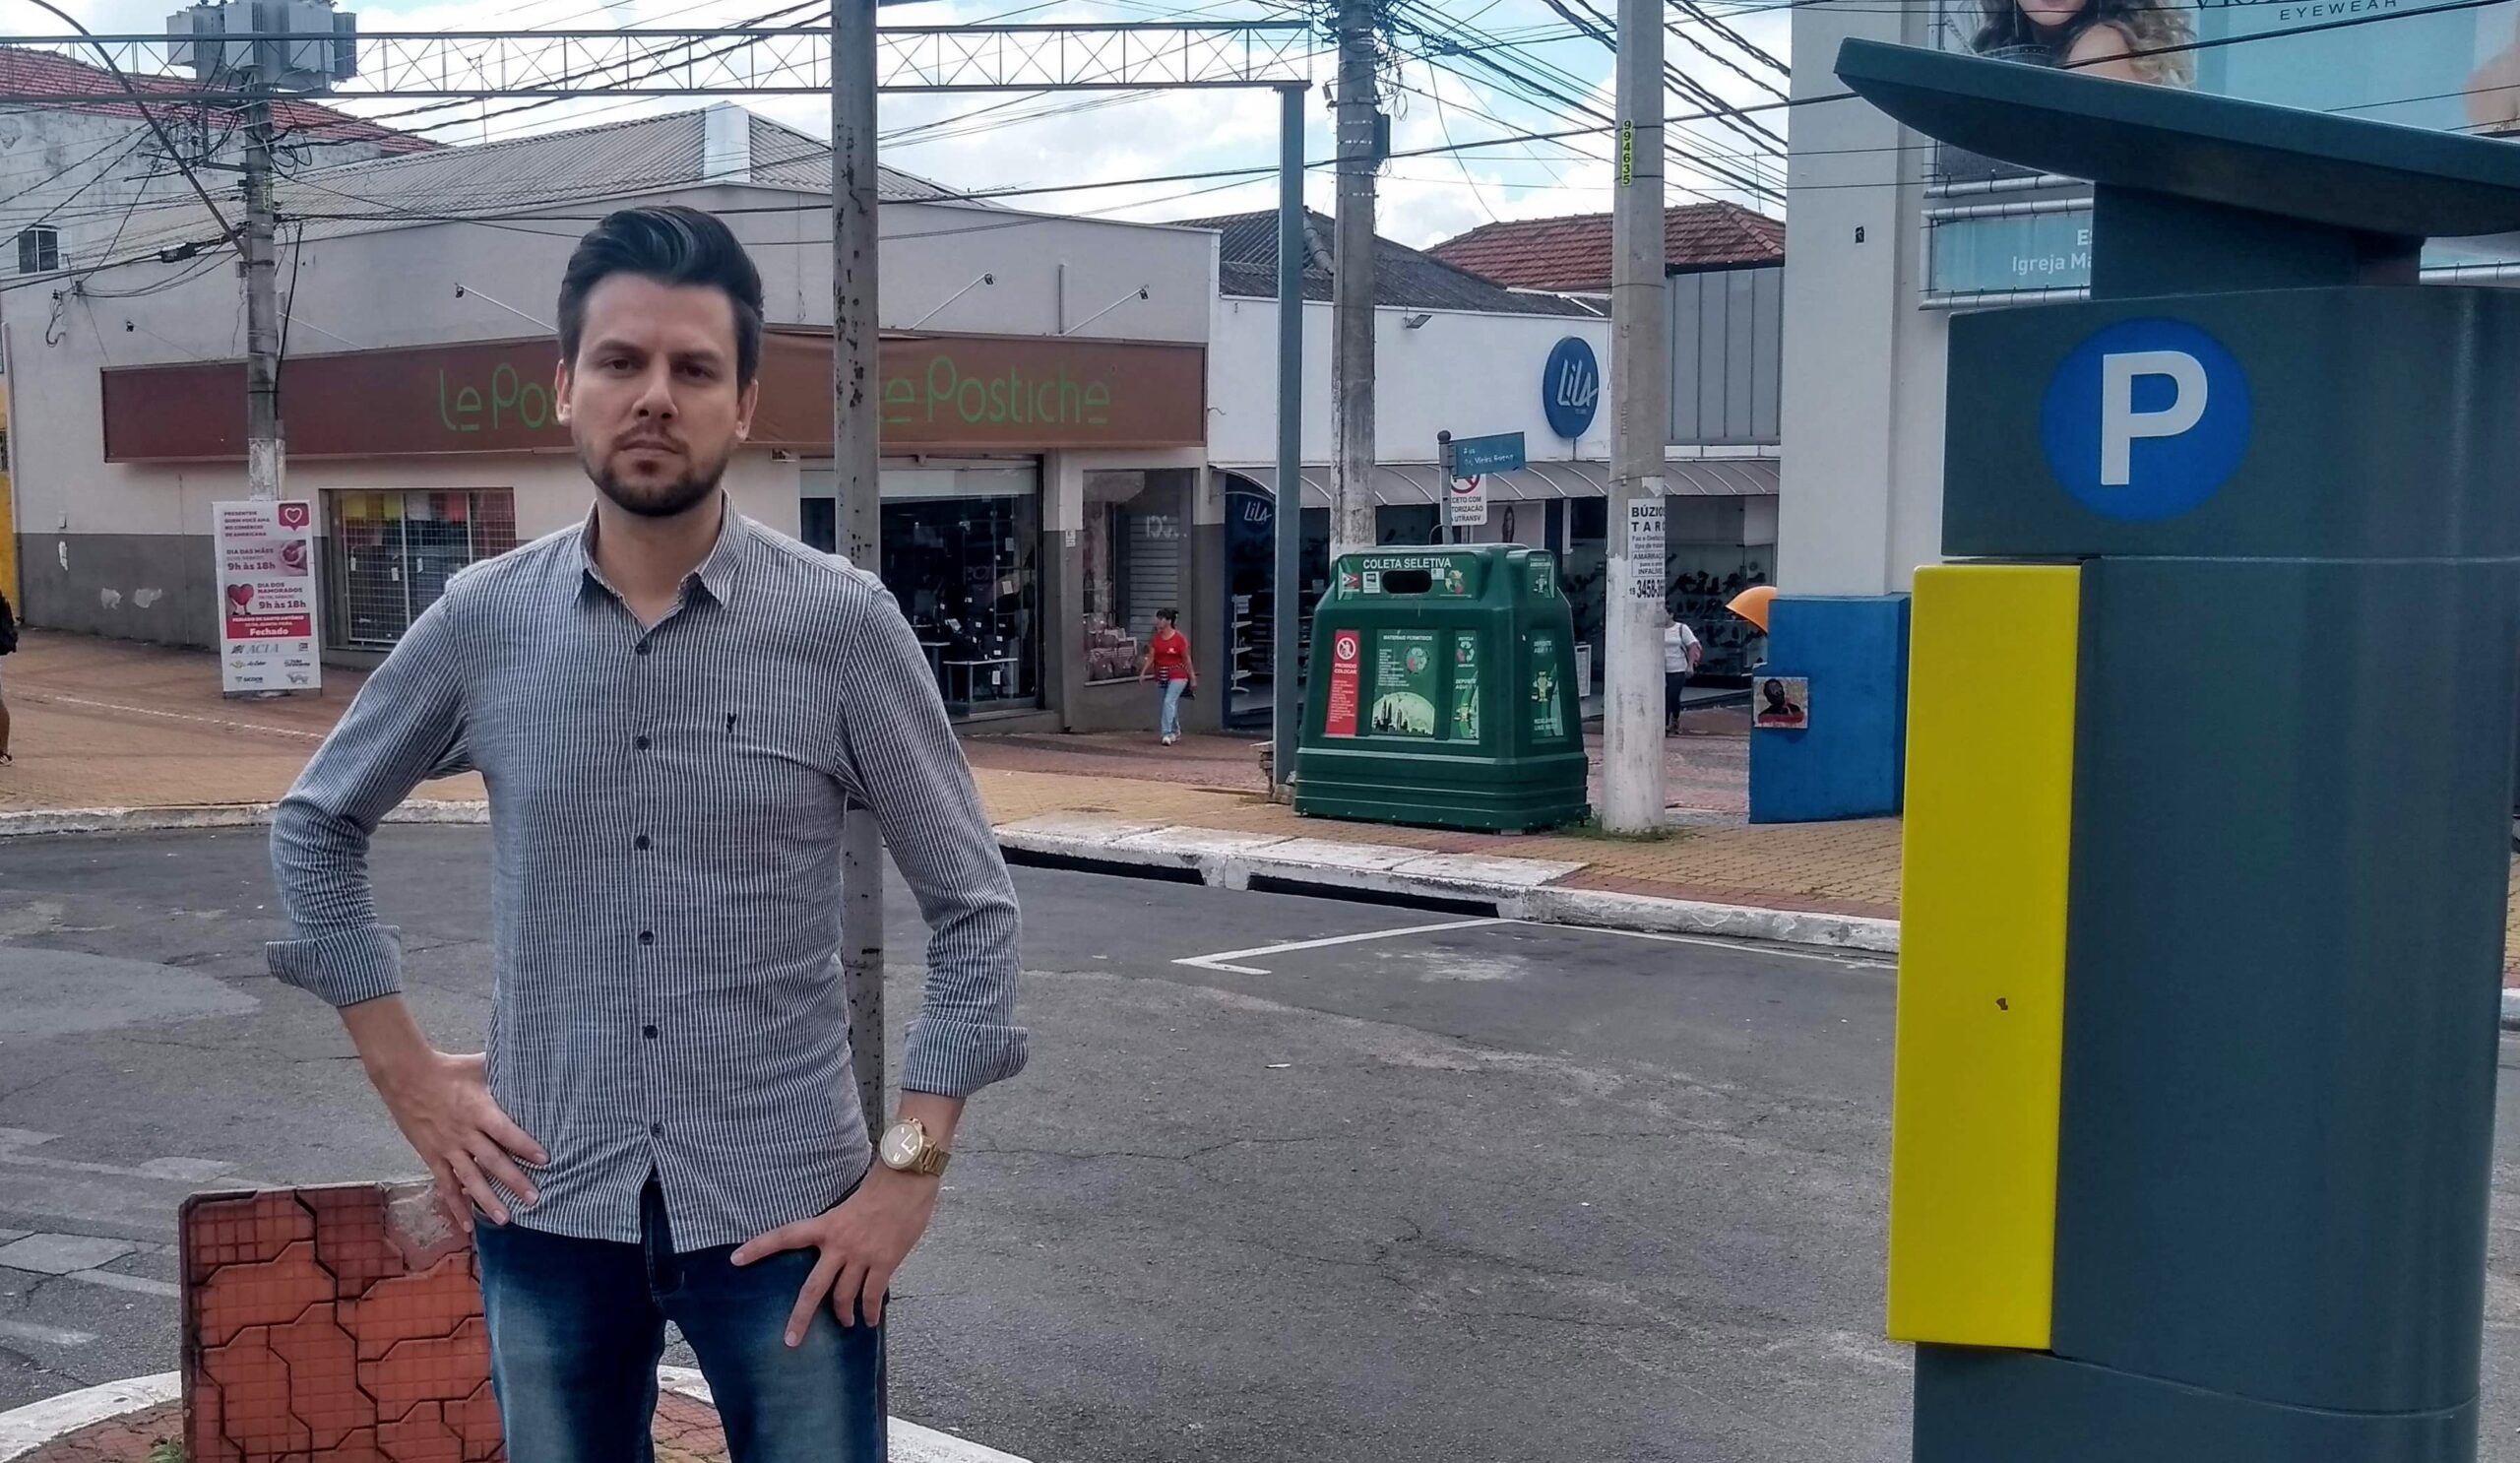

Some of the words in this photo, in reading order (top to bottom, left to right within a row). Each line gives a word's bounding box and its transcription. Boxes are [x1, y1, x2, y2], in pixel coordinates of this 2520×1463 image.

[2280, 0, 2397, 21] EYEWEAR
[1622, 120, 1632, 185] 994635
[2077, 228, 2093, 246] E
[2012, 254, 2065, 276] Igreja
[879, 377, 915, 423] e
[926, 354, 1111, 424] Postiche
[439, 369, 482, 431] Le
[2101, 350, 2209, 486] P
[243, 561, 255, 570] às
[257, 561, 276, 570] 18h
[1362, 558, 1402, 569] COLETA
[1404, 557, 1452, 569] SELETIVA
[259, 601, 273, 609] 9h
[287, 600, 306, 608] 18h
[249, 627, 289, 636] Fechado
